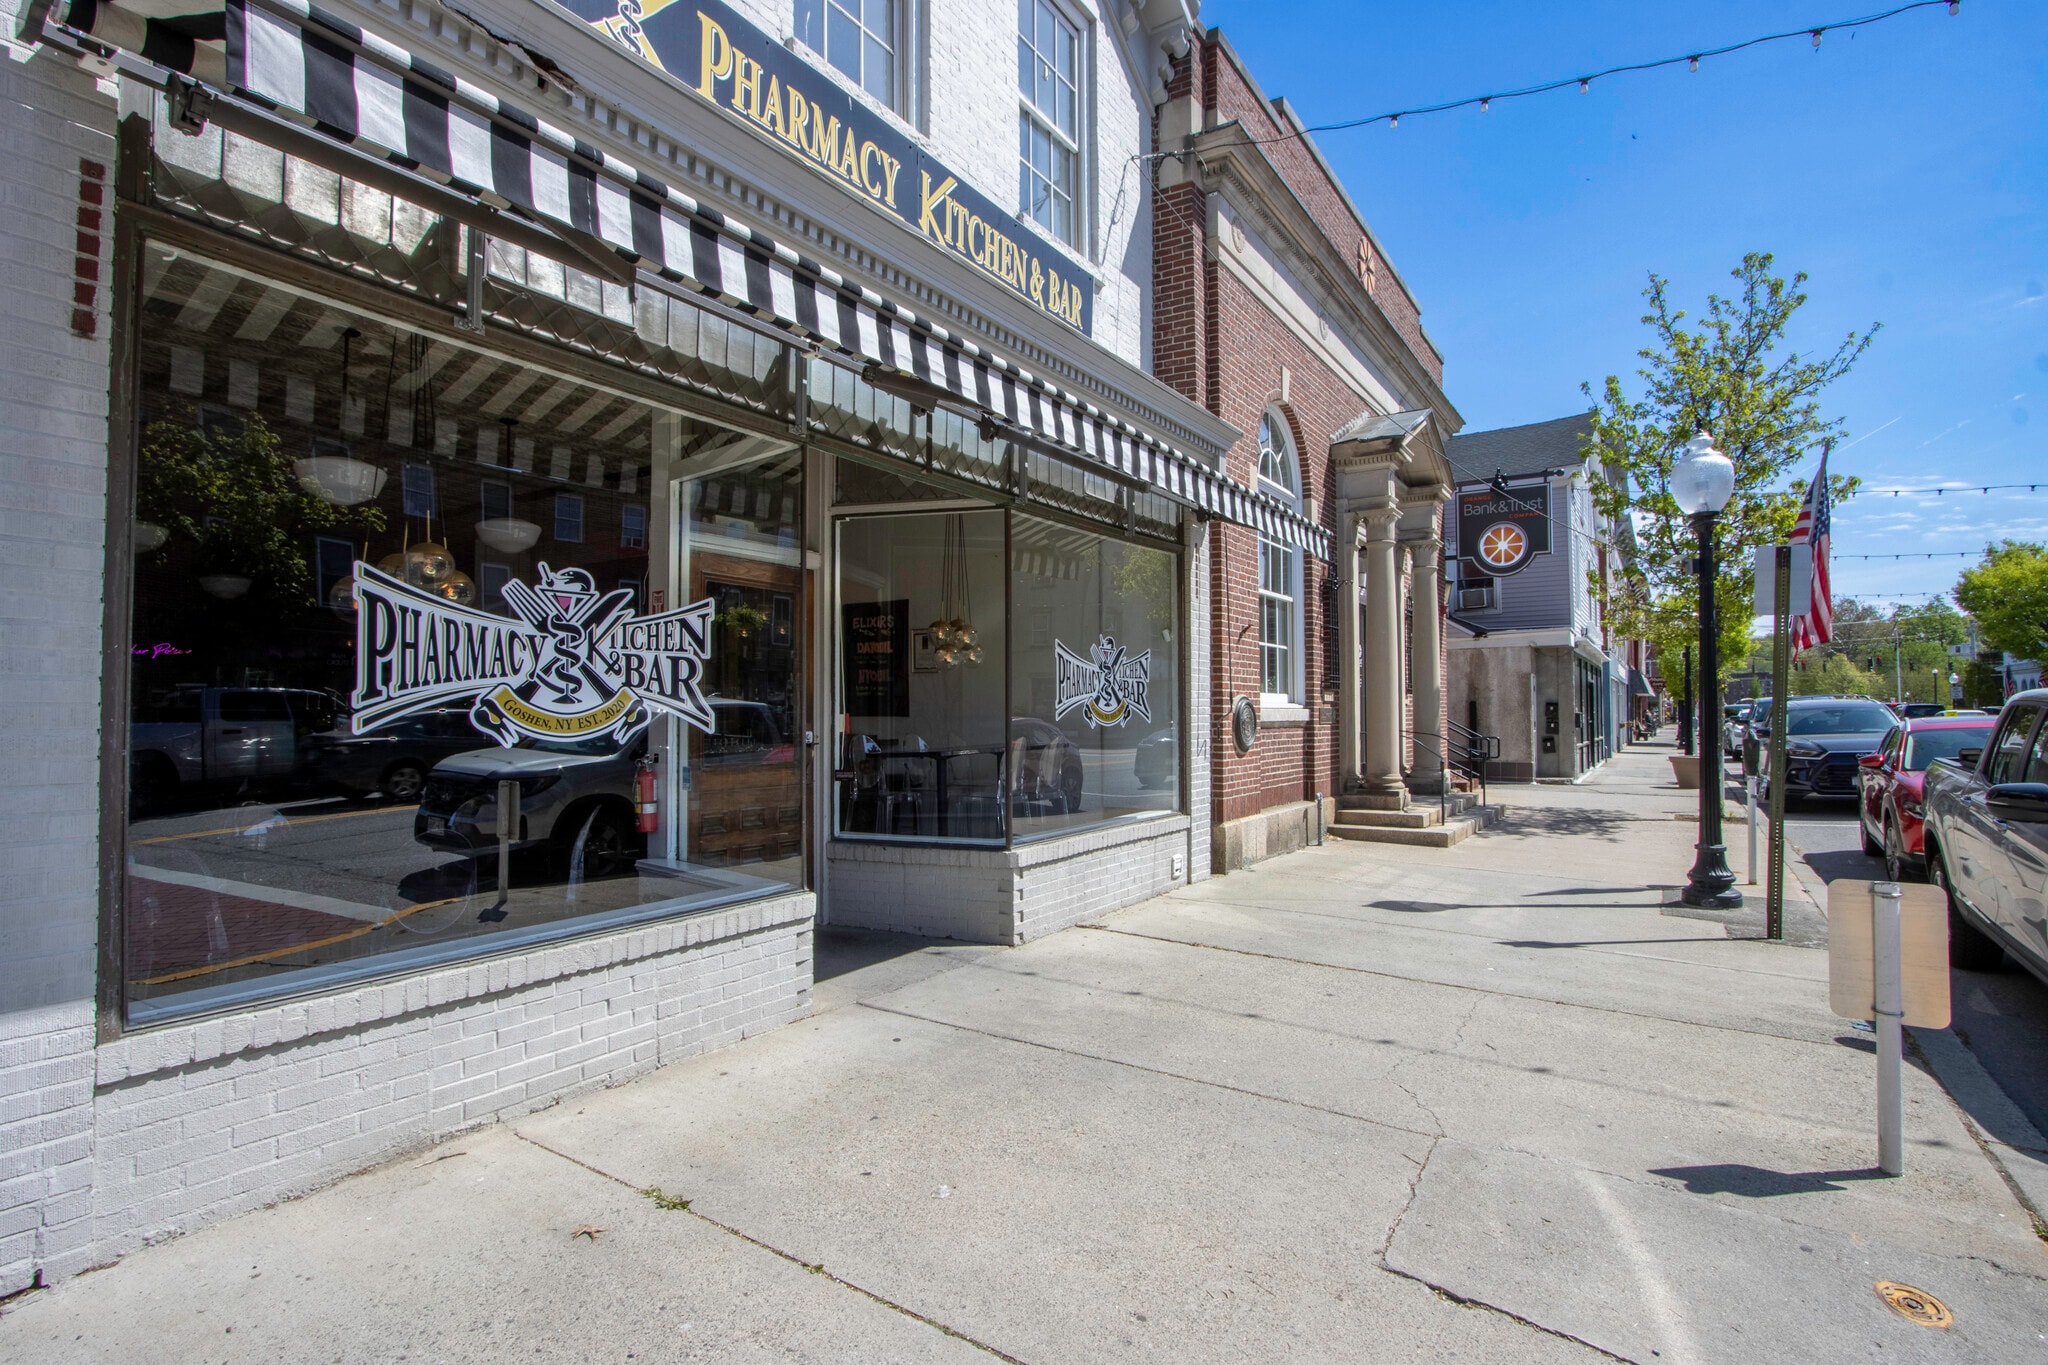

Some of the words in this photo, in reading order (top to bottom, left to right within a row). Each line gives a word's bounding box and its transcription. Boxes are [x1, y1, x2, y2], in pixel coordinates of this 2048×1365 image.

[695, 10, 900, 208] PHARMACY
[918, 169, 1028, 294] KITCHEN
[1030, 257, 1045, 311] &
[1048, 268, 1083, 330] BAR
[1509, 511, 1543, 519] COMPAN
[359, 587, 549, 703] PHARMACY
[585, 610, 711, 668] KITCHEN
[852, 615, 895, 629] ELIXIRS
[604, 651, 623, 676] &
[621, 653, 711, 718] BAR
[1057, 651, 1103, 705] PHARMACY
[1123, 680, 1150, 715] BAR
[503, 699, 553, 731] GOSHEN,
[555, 718, 574, 731] NY
[578, 713, 602, 729] EST.
[602, 699, 627, 720] 2020
